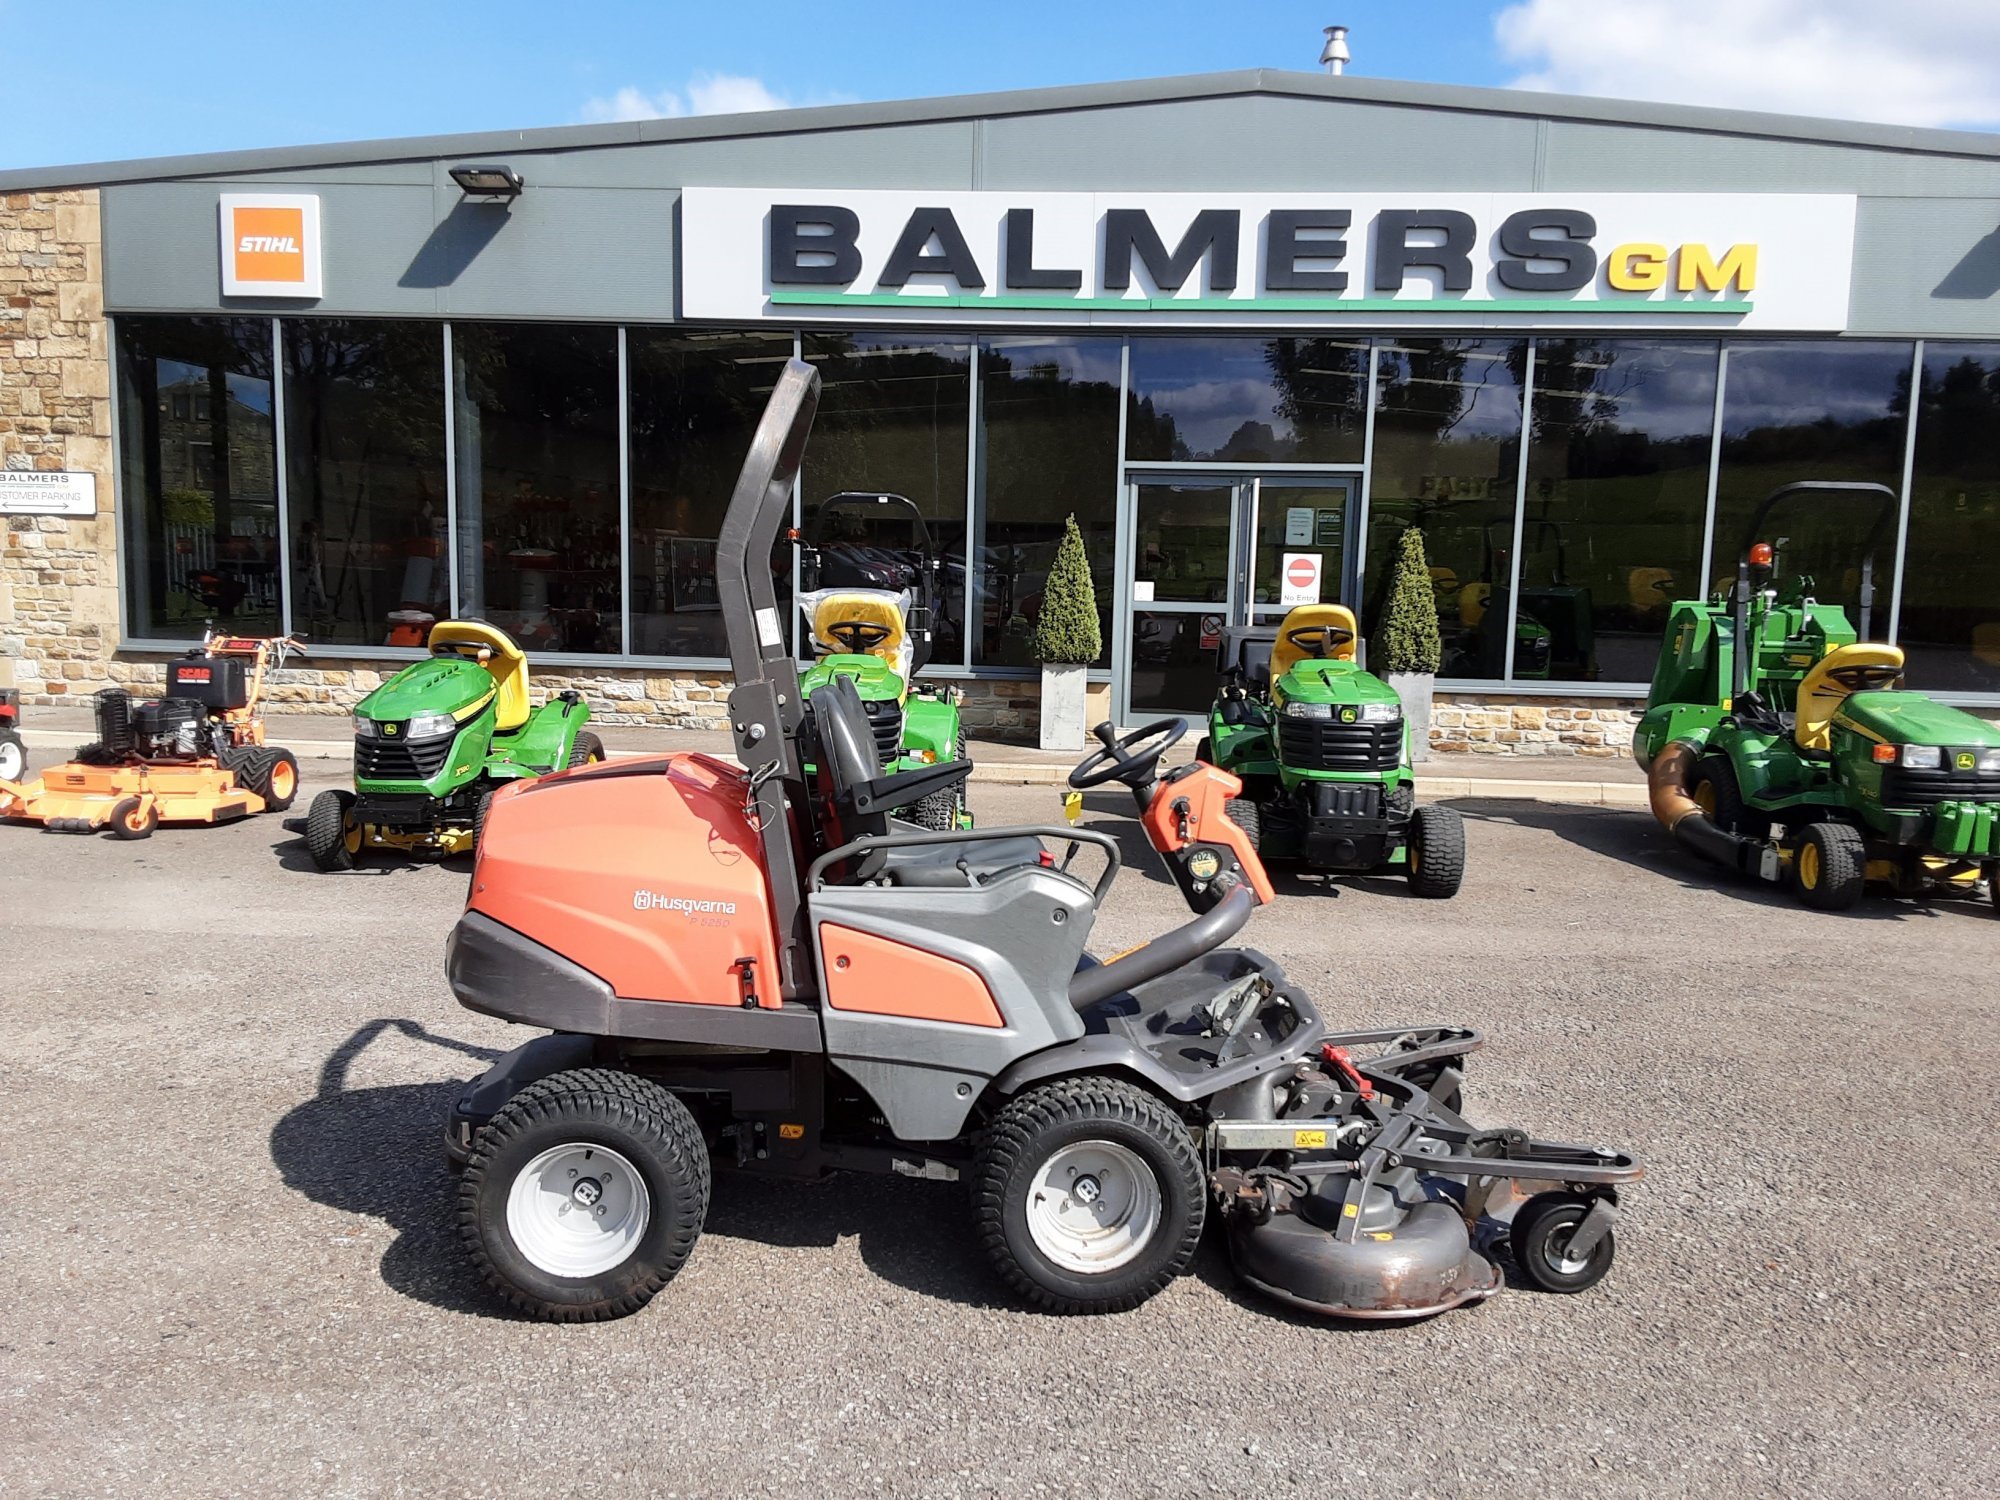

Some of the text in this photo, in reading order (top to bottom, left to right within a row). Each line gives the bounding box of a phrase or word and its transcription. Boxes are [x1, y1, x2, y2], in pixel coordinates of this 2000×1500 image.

[239, 236, 299, 253] STIHL
[771, 204, 1758, 292] BALMERS GM
[0, 474, 69, 483] BALMERS
[0, 491, 81, 501] STOMER PARKING
[1296, 595, 1317, 603] Entry
[177, 667, 211, 679] SCAG
[651, 893, 737, 917] Husqvarna
